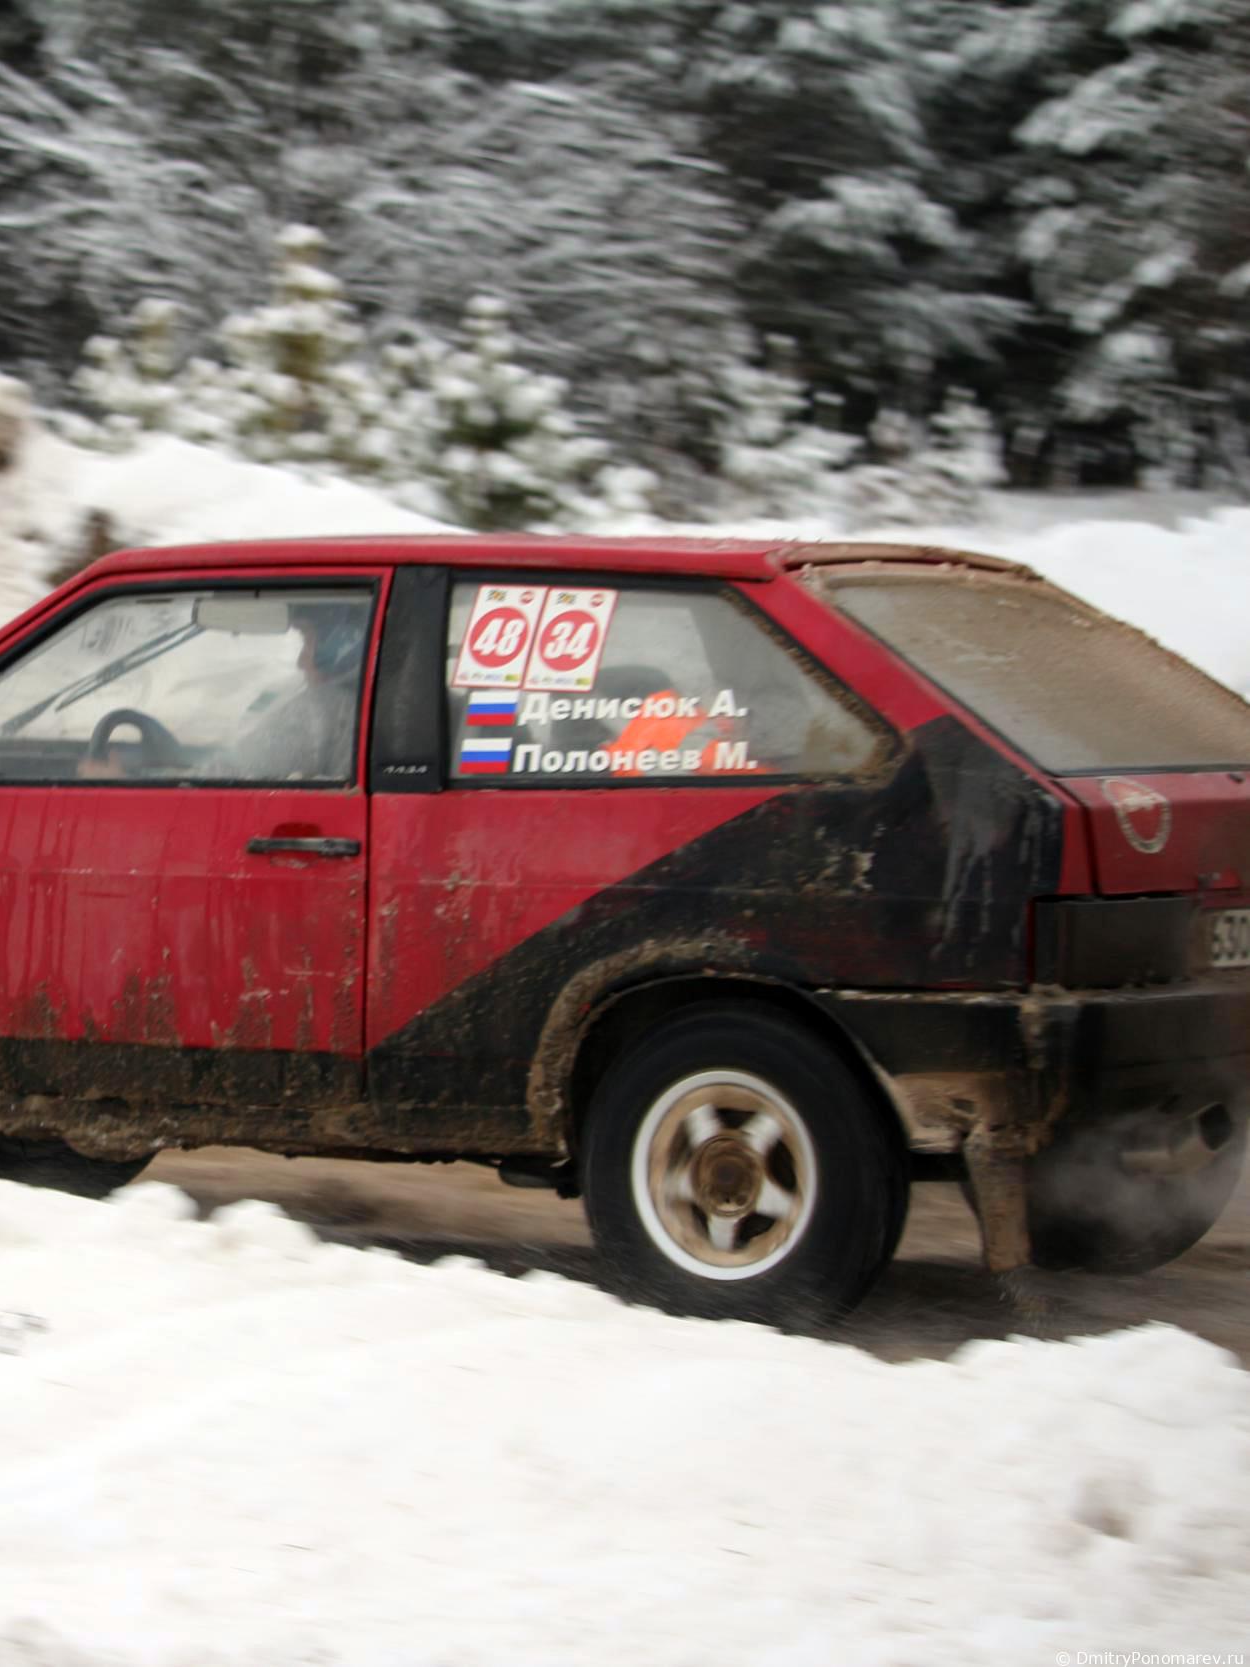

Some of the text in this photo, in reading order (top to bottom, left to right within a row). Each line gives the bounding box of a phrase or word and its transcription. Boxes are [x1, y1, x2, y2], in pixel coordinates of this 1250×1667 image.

[473, 617, 527, 657] 48
[543, 621, 596, 660] 34
[518, 688, 748, 726] Денисюк А.
[513, 741, 759, 773] Полонеев М.
